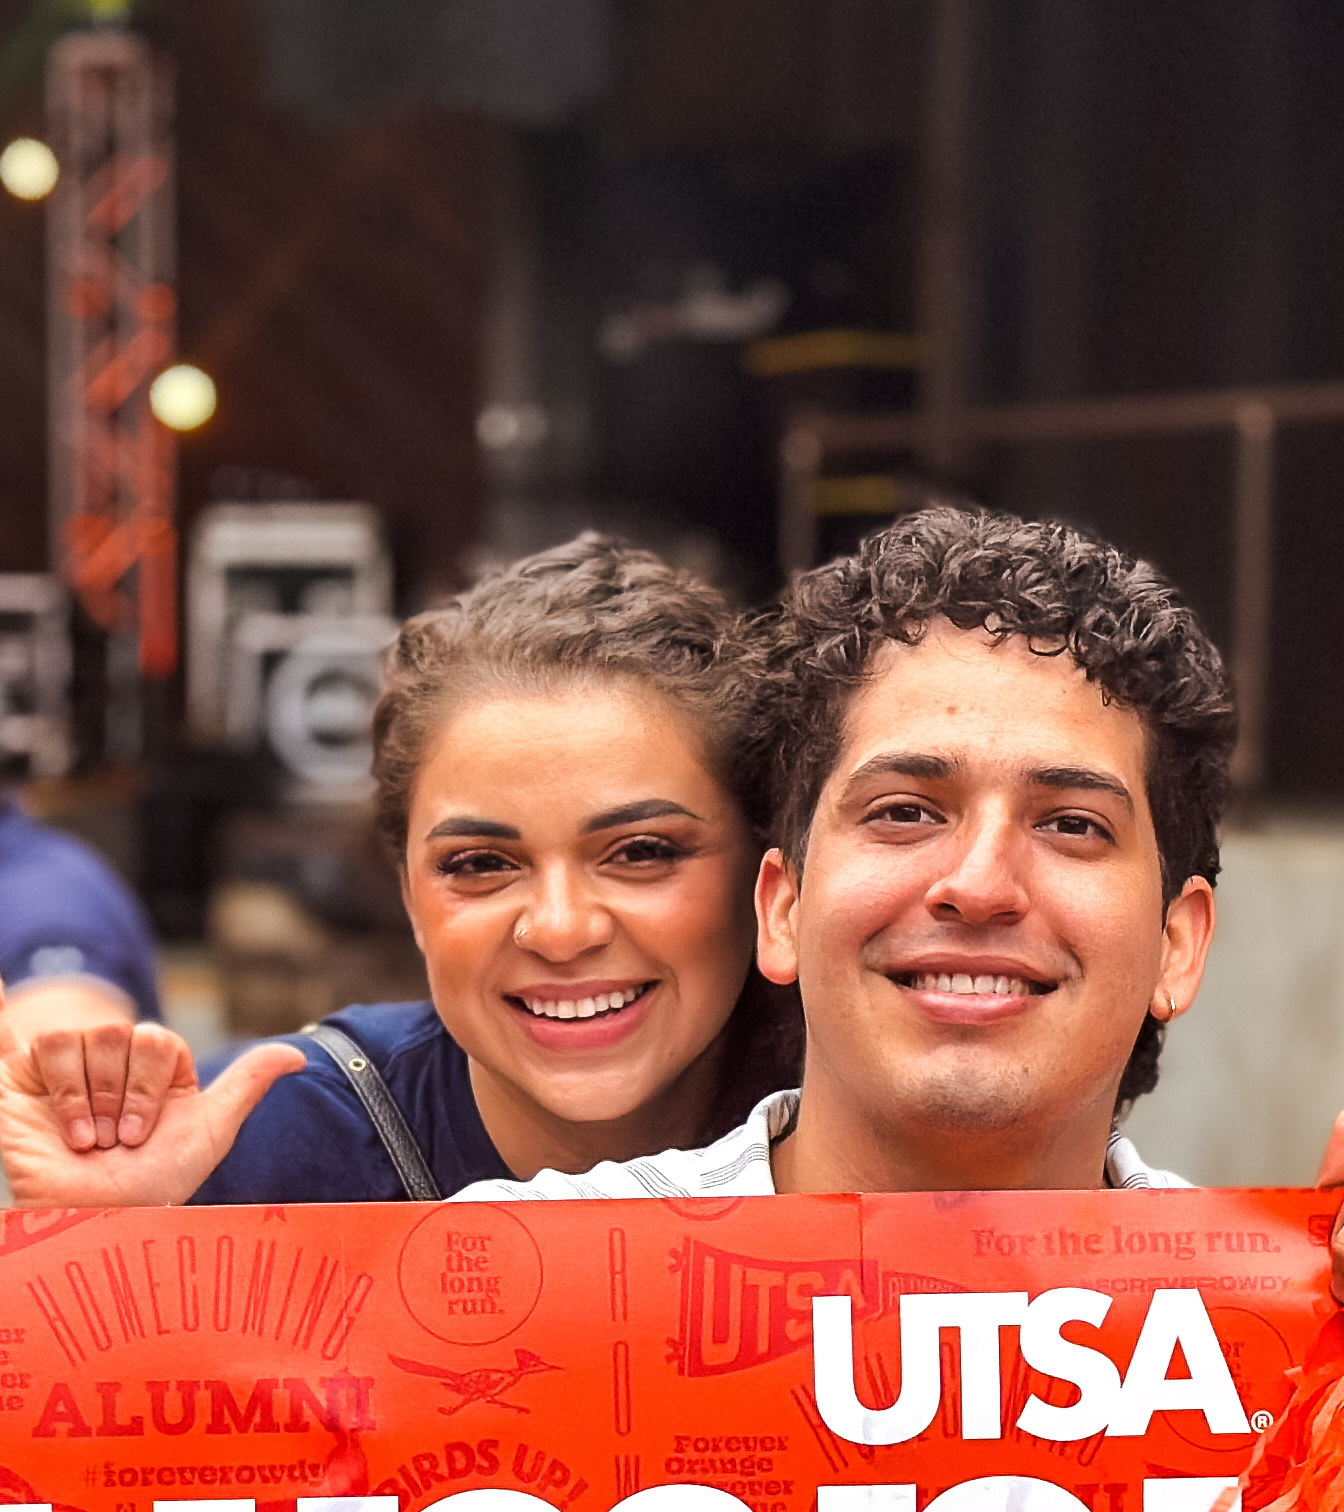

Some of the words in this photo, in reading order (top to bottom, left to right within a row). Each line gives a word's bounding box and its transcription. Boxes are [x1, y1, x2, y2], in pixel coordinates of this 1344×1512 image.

[446, 1232, 491, 1252] For
[1044, 1225, 1101, 1256] the
[1113, 1225, 1195, 1261] long
[1208, 1229, 1281, 1255] run.
[445, 1252, 488, 1273] the
[440, 1273, 500, 1297] long
[447, 1297, 505, 1316] run.
[31, 1376, 377, 1438] ALUMNI
